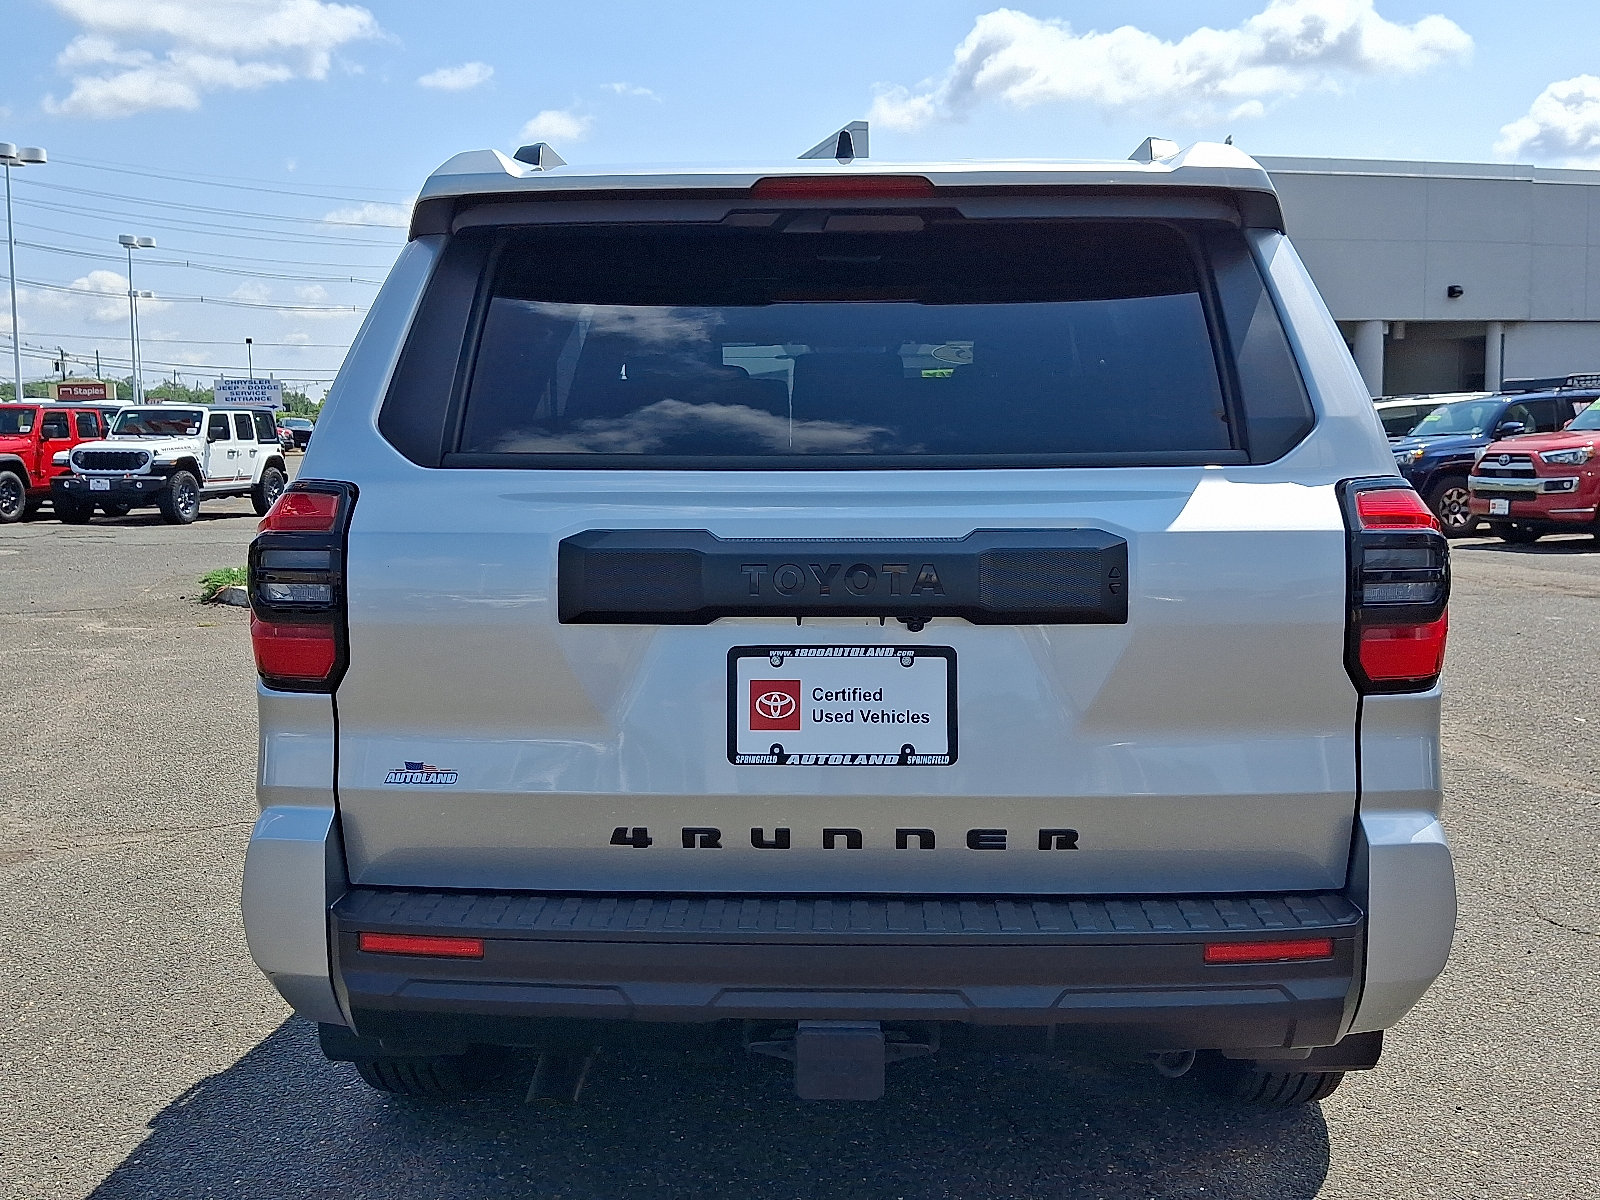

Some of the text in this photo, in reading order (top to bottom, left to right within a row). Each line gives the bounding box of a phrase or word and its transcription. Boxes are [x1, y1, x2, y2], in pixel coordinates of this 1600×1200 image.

[73, 387, 105, 396] Staples
[741, 563, 946, 597] TOYOTA
[812, 687, 884, 702] Certified
[812, 709, 931, 724] Used Vehicles
[735, 754, 950, 765] SPRINGFIELD AUTOLAND SPRINGFIELD
[385, 771, 458, 784] AUTOLAND
[610, 826, 1080, 850] 4RUNNER
